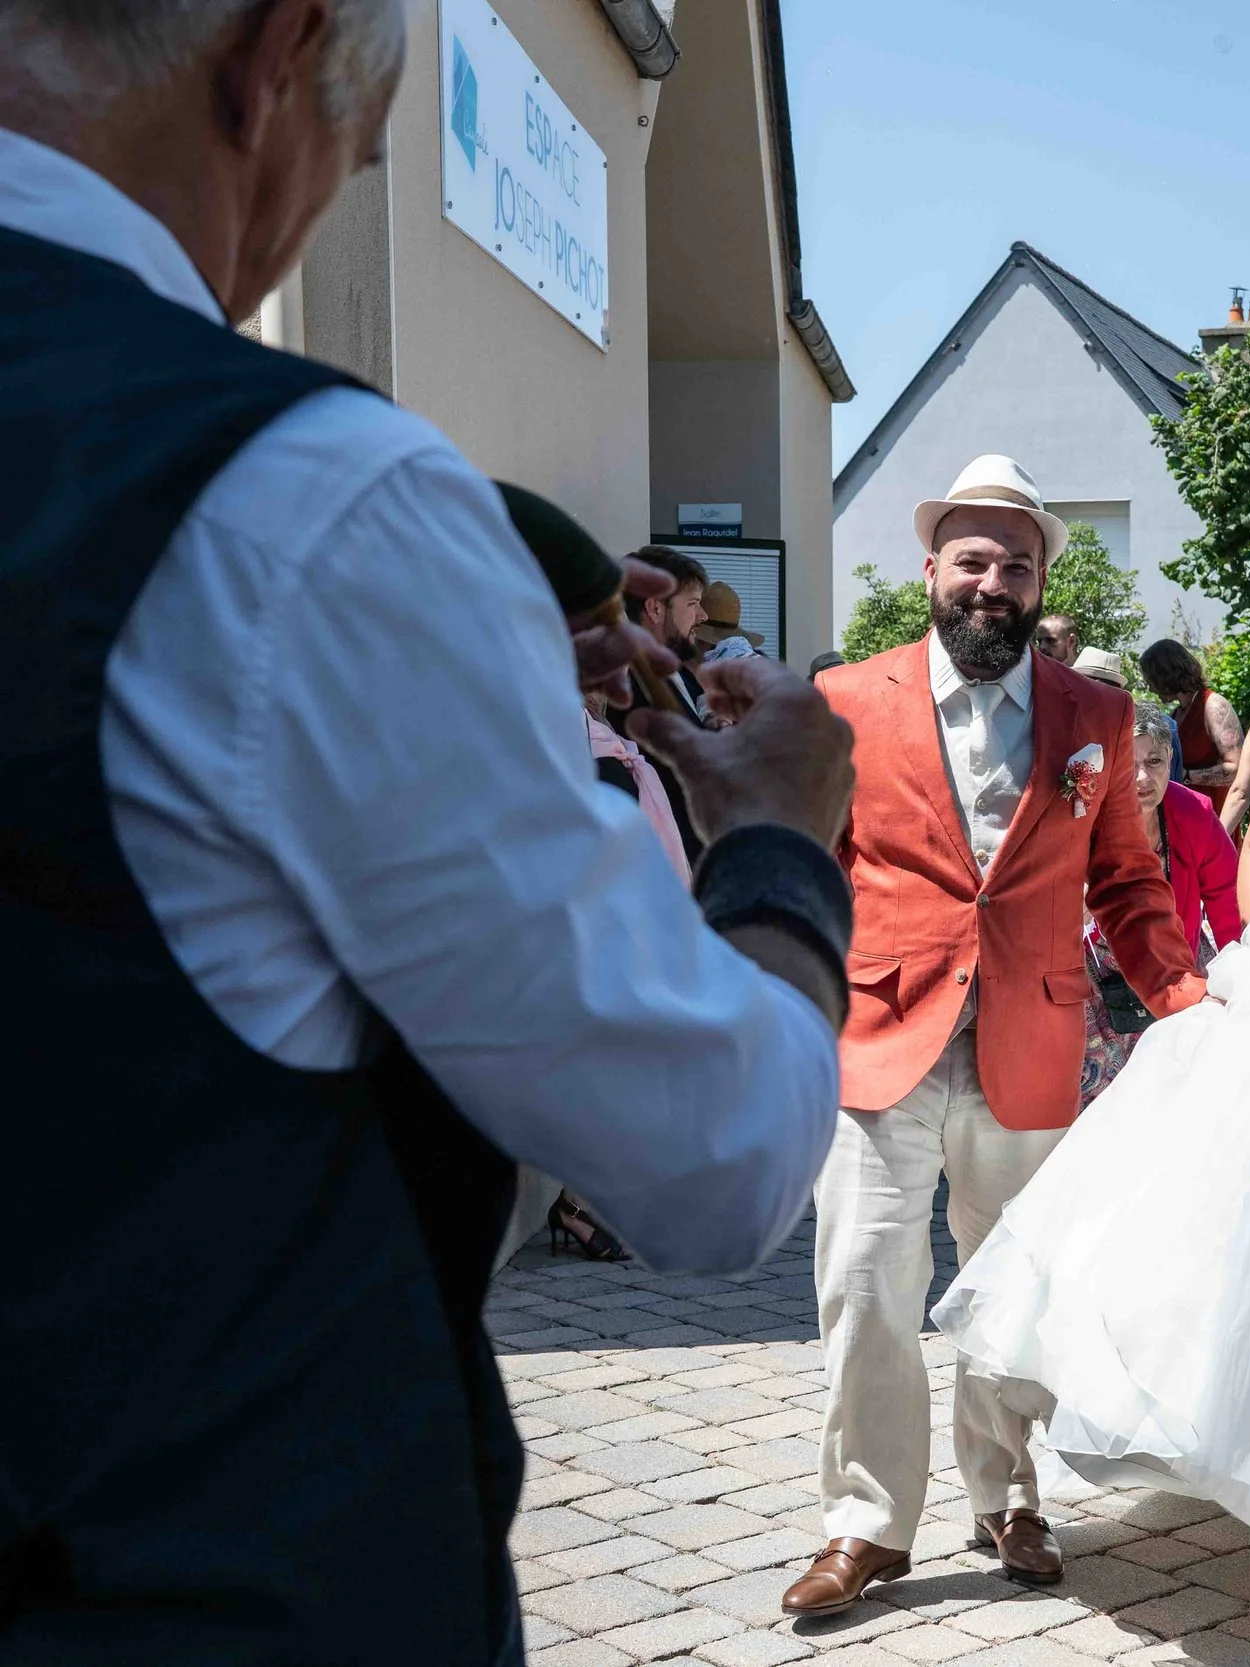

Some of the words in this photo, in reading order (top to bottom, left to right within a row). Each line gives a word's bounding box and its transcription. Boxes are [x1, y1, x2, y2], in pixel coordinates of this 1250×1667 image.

[525, 91, 580, 207] ESPACE
[495, 158, 551, 269] JOSEPH
[555, 219, 604, 312] PICHOT
